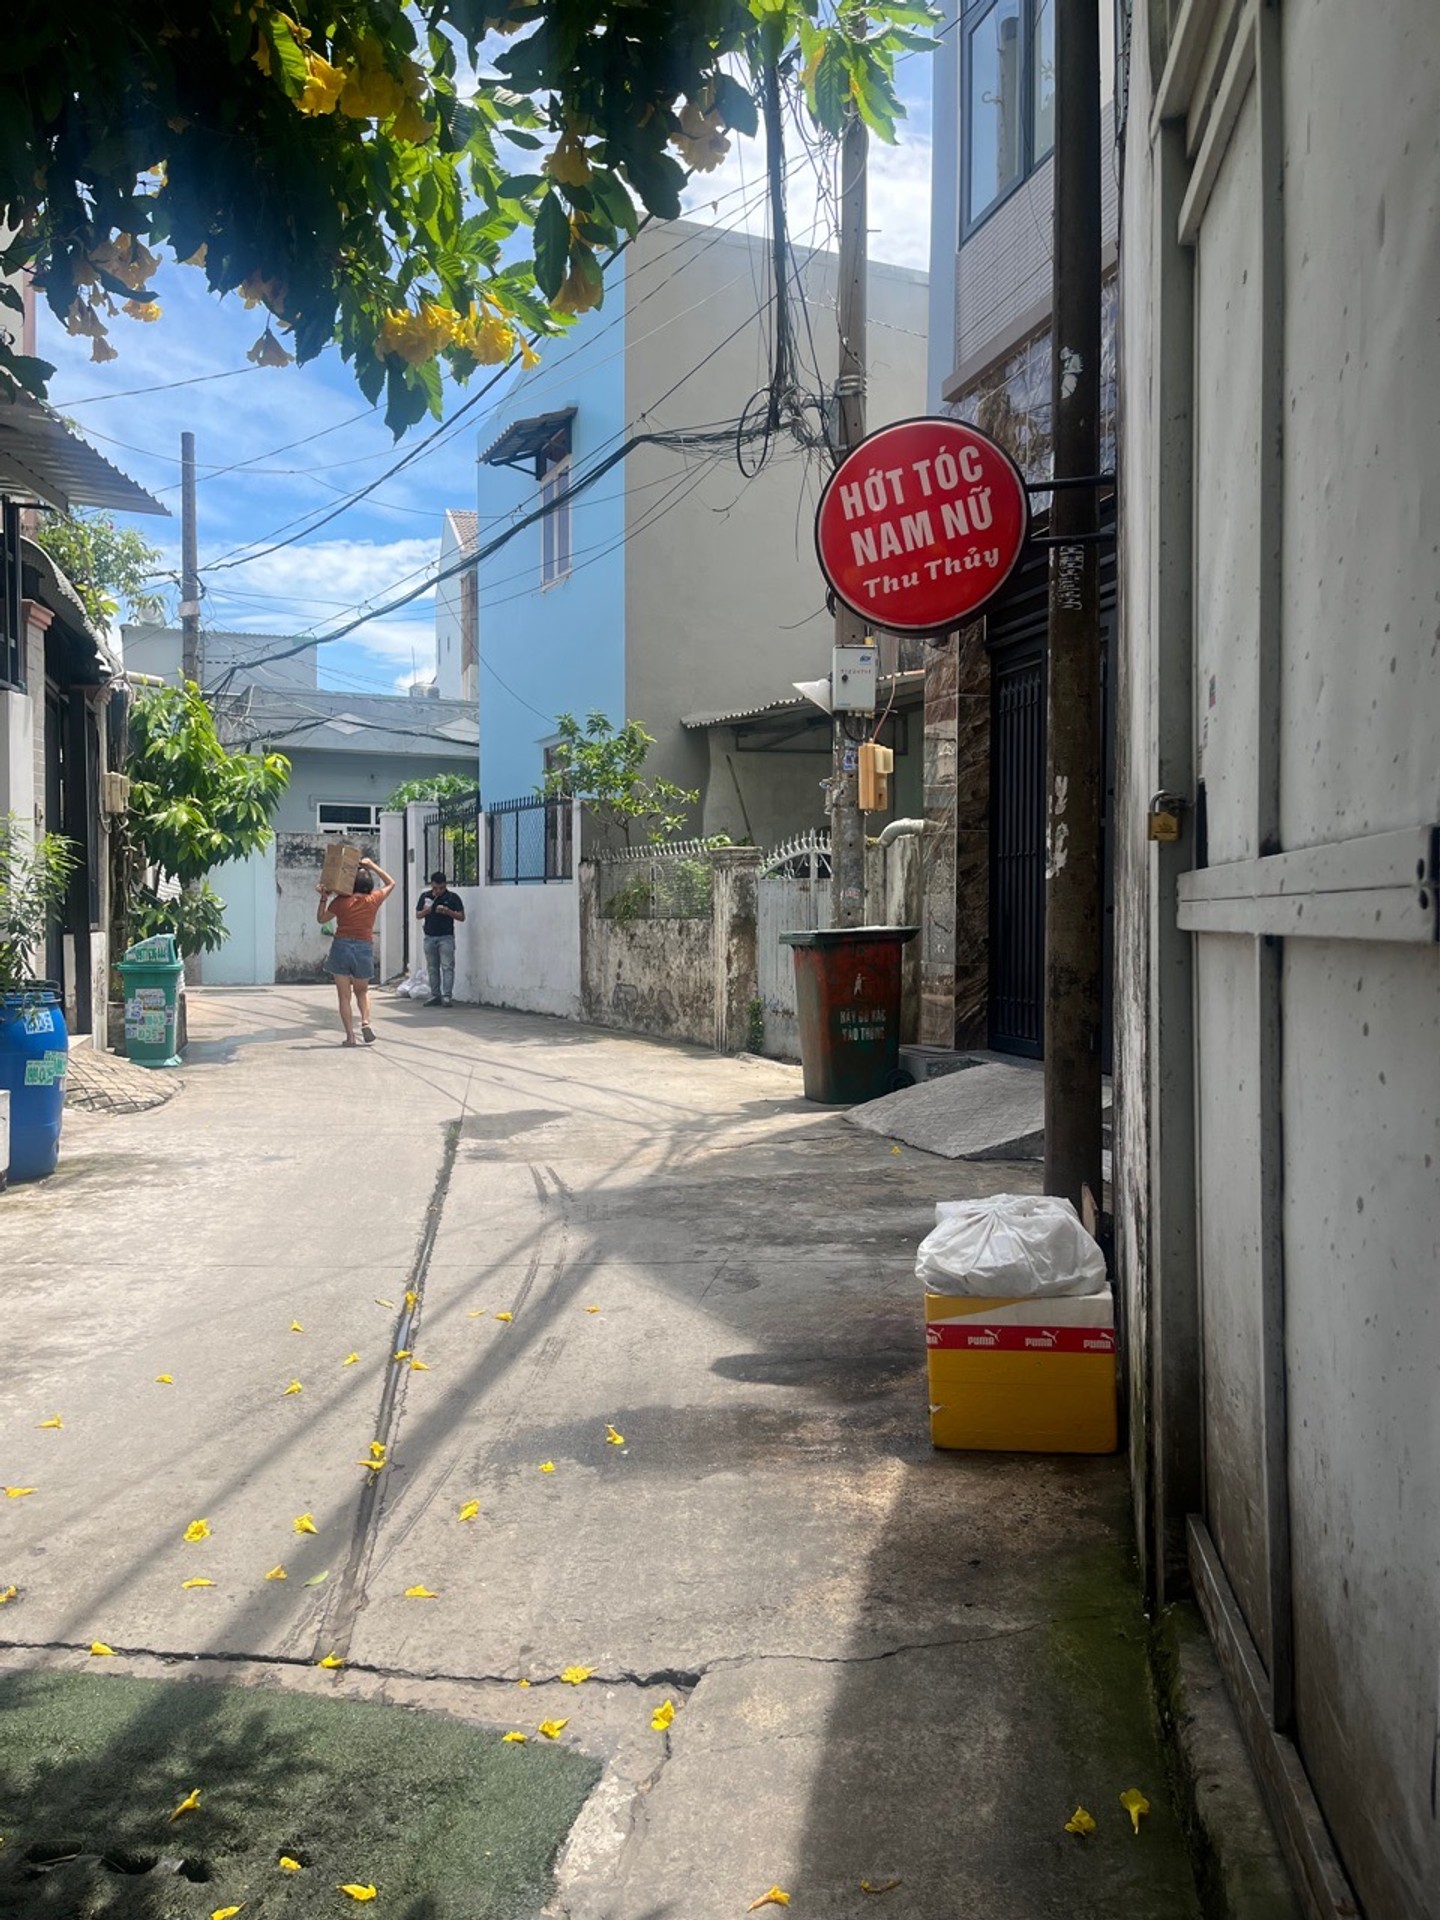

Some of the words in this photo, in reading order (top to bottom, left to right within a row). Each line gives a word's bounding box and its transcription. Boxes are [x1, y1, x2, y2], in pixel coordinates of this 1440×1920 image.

[839, 468, 905, 520] HỚT
[912, 445, 983, 496] TÓC
[850, 510, 935, 567] NAM
[940, 485, 993, 540] NỮ
[863, 571, 919, 598] Thu
[924, 546, 999, 580] Thủy
[967, 1336, 995, 1345] PUMA
[1025, 1337, 1052, 1347] PUMA
[1083, 1339, 1111, 1349] PUMA
